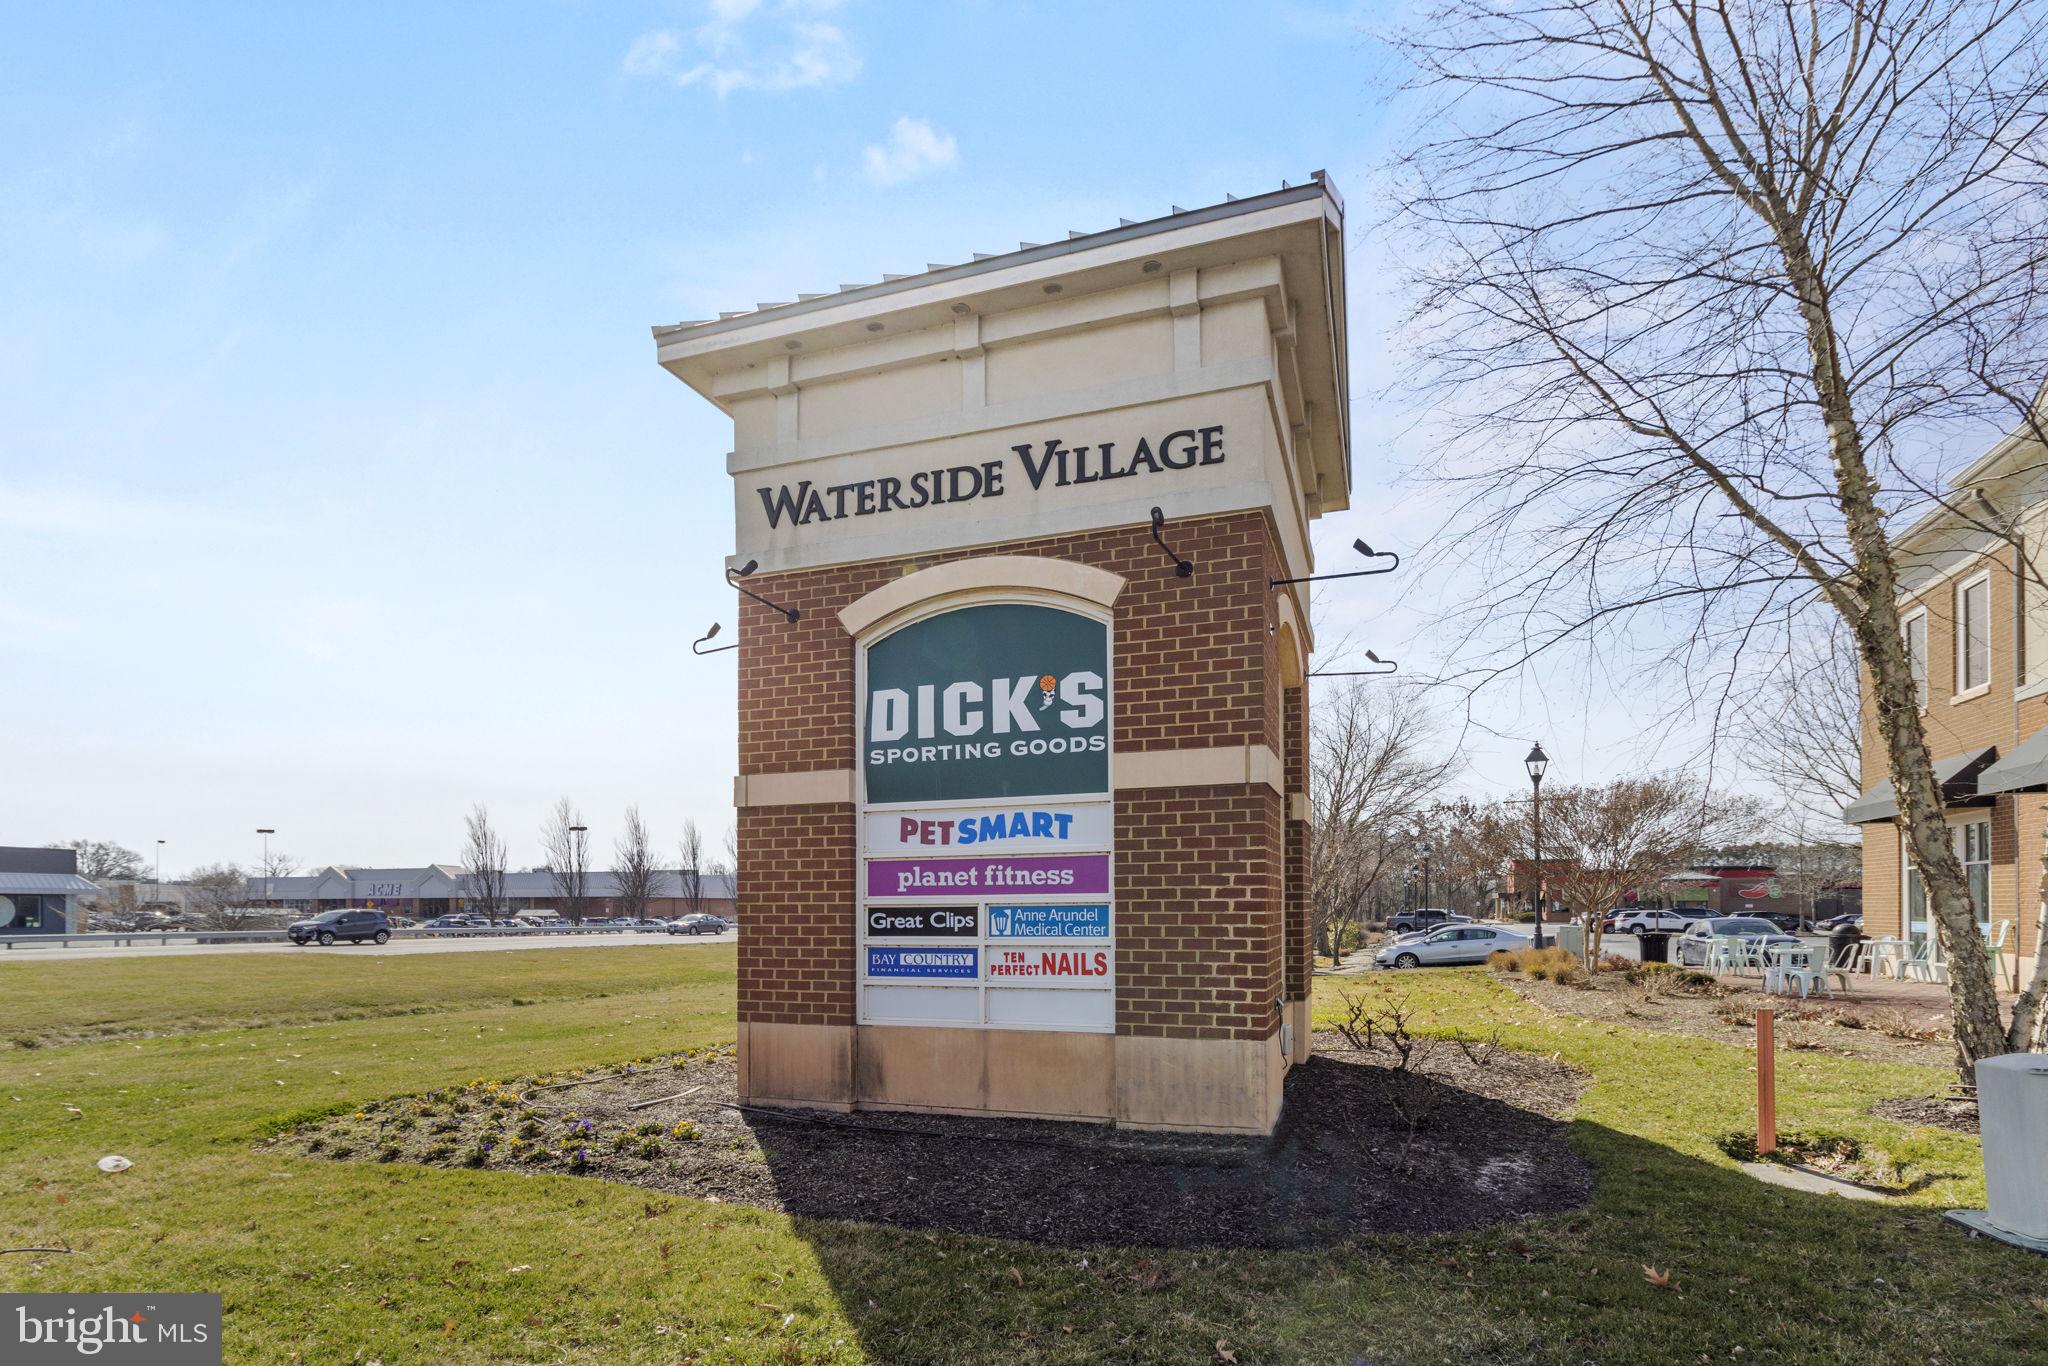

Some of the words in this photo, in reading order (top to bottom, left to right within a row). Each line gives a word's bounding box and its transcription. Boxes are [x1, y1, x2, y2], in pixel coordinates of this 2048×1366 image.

[870, 671, 1104, 743] DICK'S
[869, 742, 1002, 765] SPORTING
[1009, 735, 1107, 756] GOODS
[897, 866, 978, 892] planet
[984, 864, 1075, 886] fitness
[367, 883, 401, 896] ACME
[870, 912, 924, 929] Great
[930, 911, 975, 932] Clips
[1014, 909, 1047, 922] Anne
[1049, 909, 1098, 922] Arundel
[1014, 923, 1063, 936] Medical
[1065, 922, 1106, 936] Center
[871, 954, 897, 965] BAY
[902, 953, 971, 966] COUNTRY
[1003, 952, 1025, 963] TEN
[1041, 952, 1108, 976] NAILS
[990, 964, 1040, 976] PERFECT
